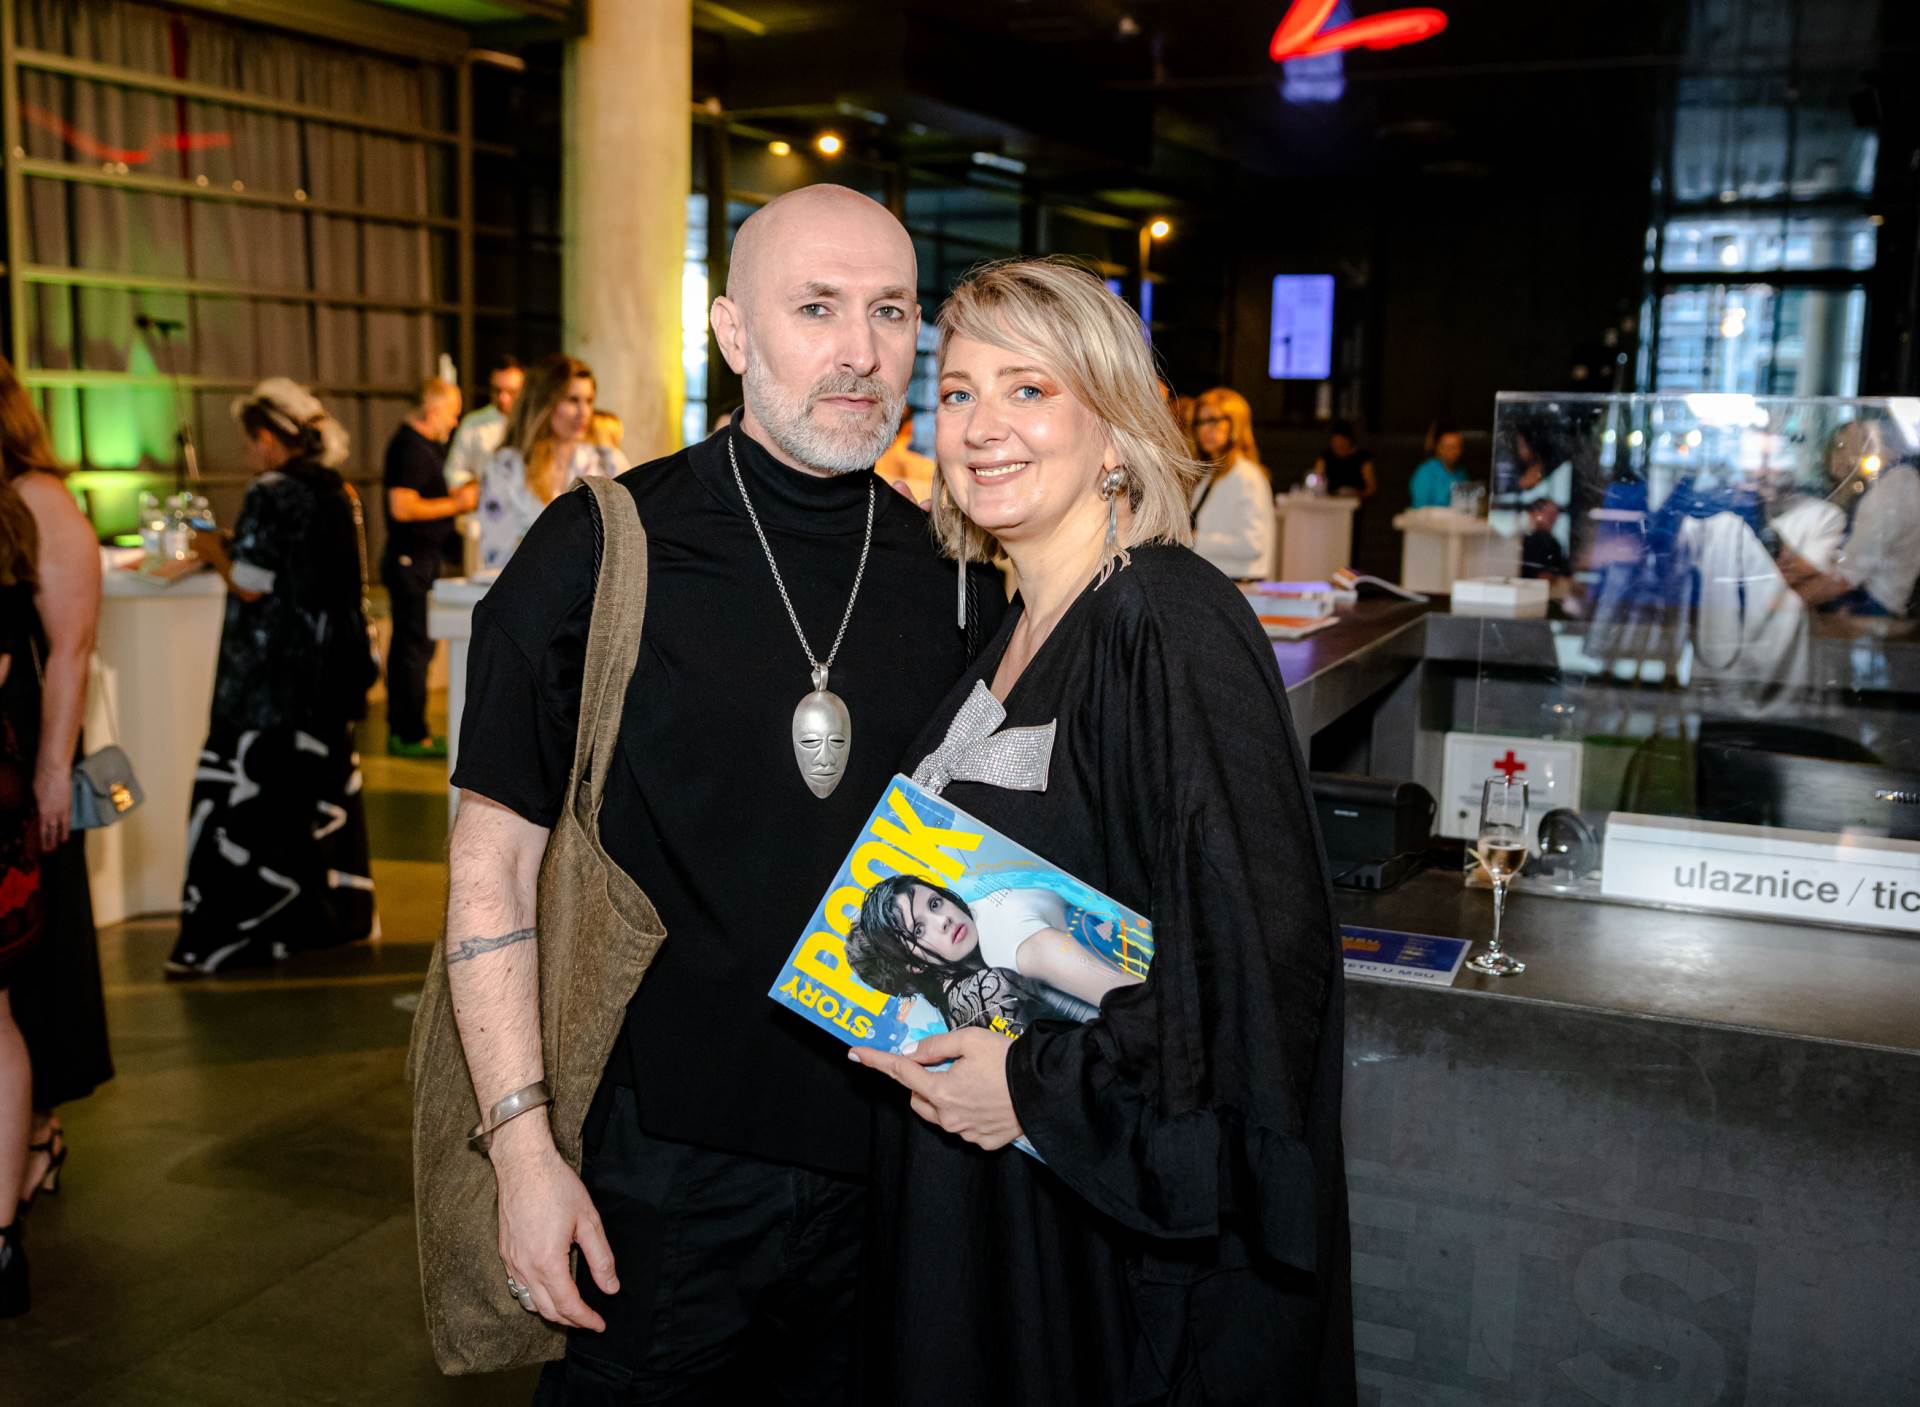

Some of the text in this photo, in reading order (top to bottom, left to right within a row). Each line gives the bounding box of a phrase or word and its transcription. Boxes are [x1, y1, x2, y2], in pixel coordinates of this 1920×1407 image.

[1673, 861, 1840, 903] ulaznice
[1871, 880, 1920, 912] tic
[779, 975, 873, 1038] STORY
